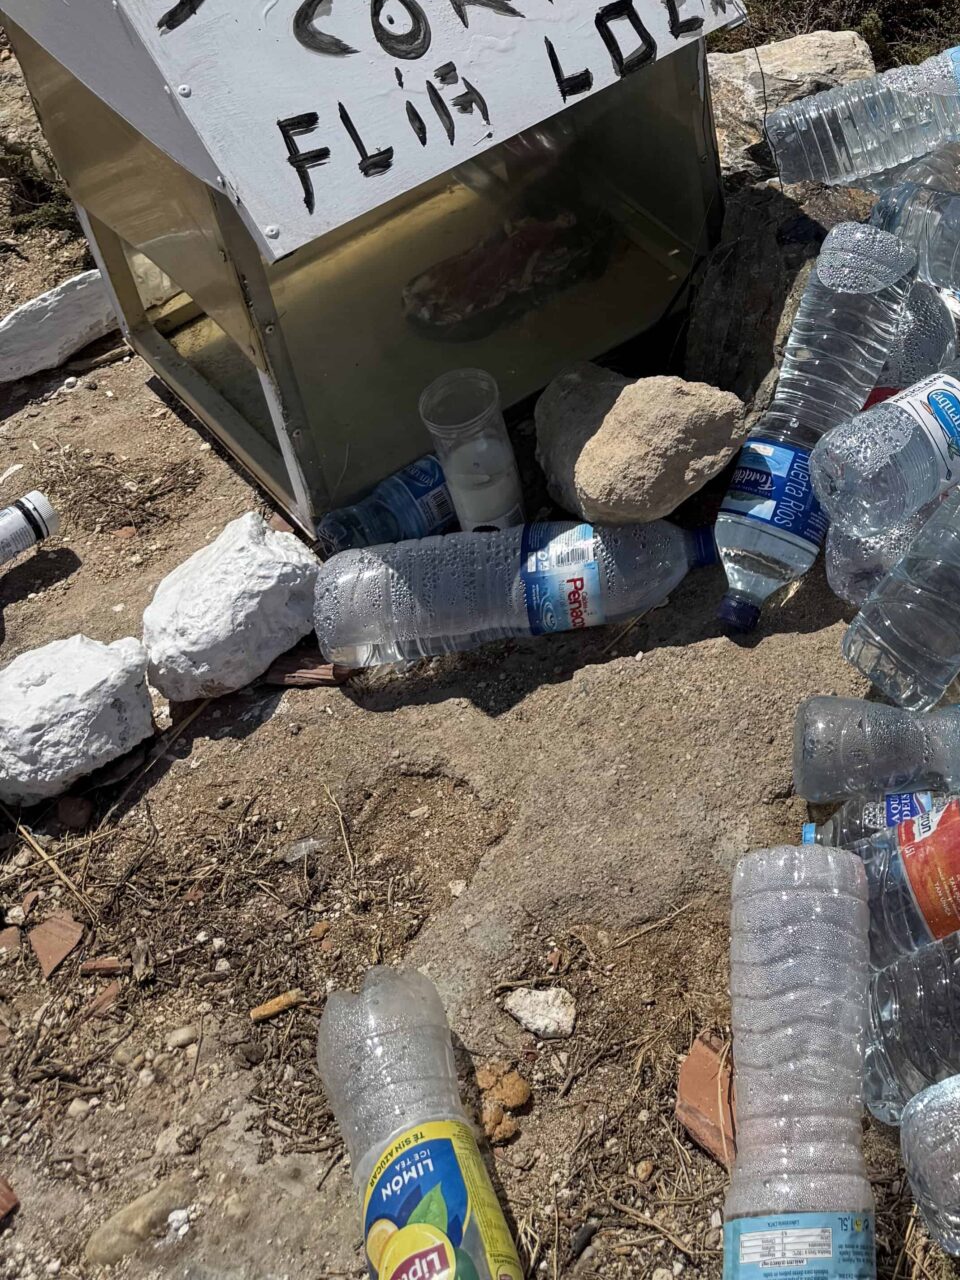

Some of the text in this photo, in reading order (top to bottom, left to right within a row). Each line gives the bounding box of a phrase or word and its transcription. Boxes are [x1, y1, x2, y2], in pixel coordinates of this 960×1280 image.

[890, 794, 900, 824] AQU
[394, 1148, 430, 1171] ICE TEA
[381, 1158, 434, 1202] LIMÓN
